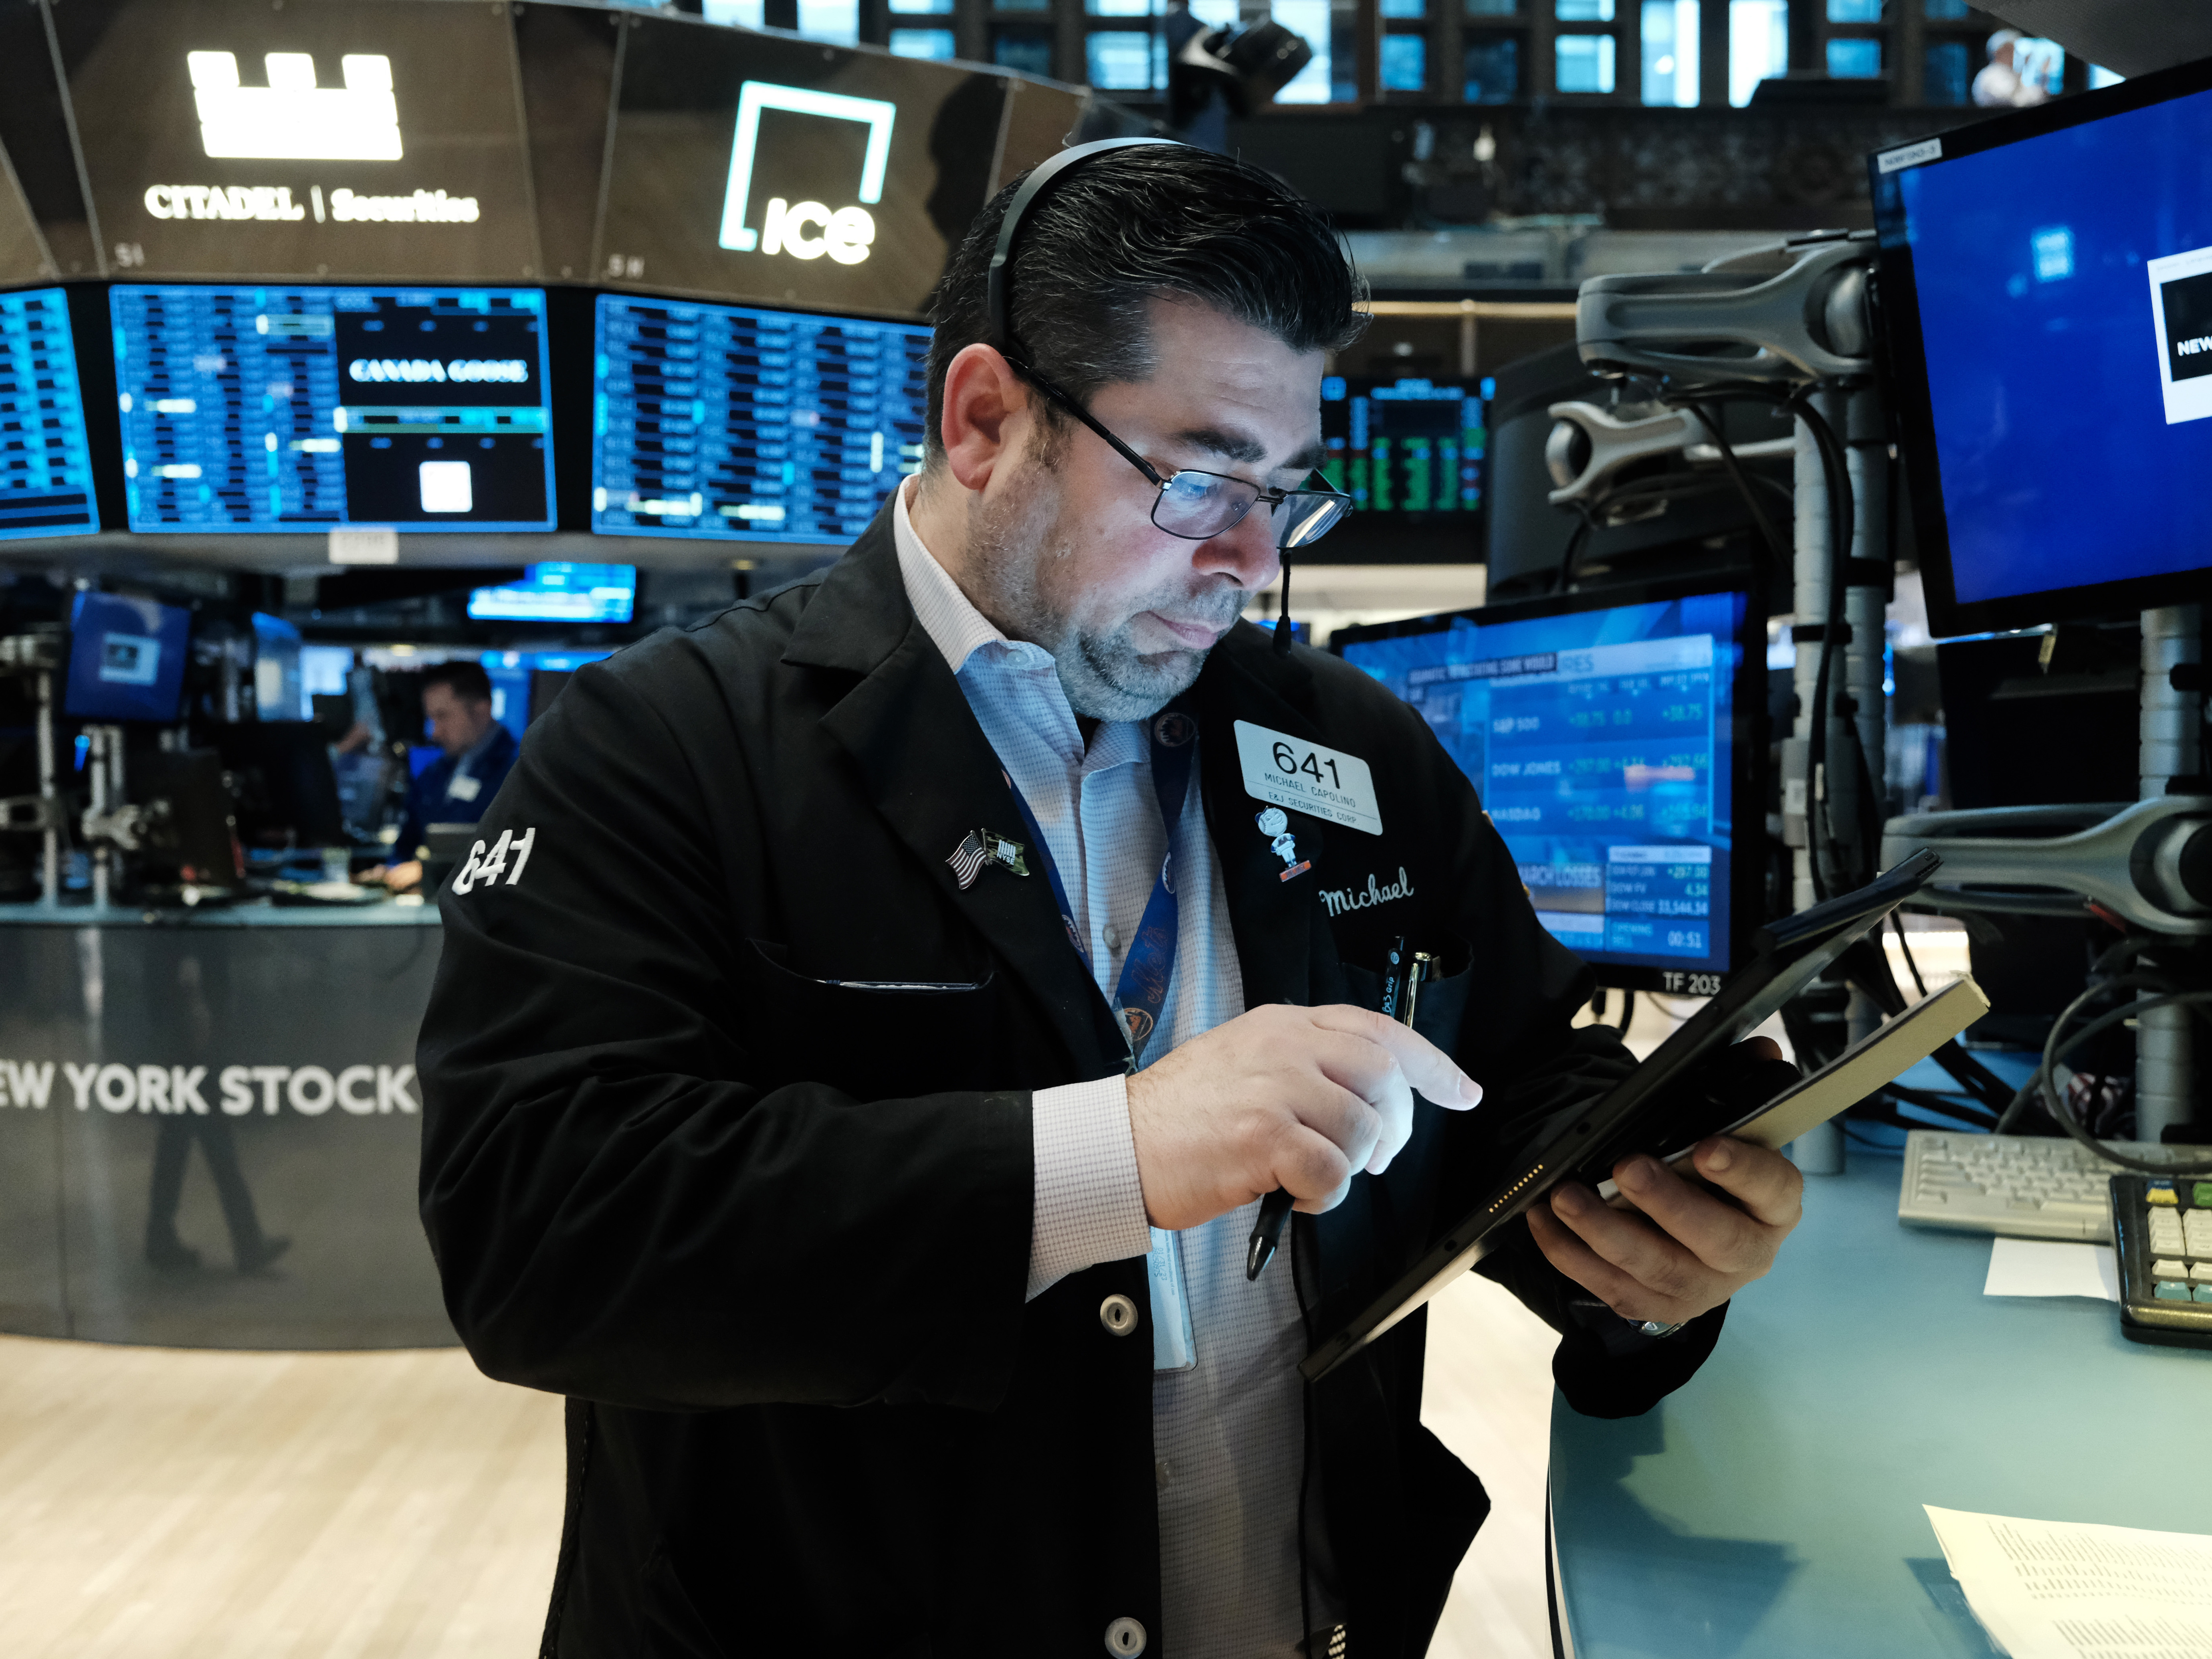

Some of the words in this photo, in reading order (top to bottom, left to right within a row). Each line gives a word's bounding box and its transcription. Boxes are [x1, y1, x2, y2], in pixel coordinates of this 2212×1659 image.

[144, 184, 305, 220] CITADEL
[331, 188, 479, 222] Securities
[1273, 742, 1341, 789] 641
[1264, 772, 1306, 792] MICHAEL
[1311, 786, 1356, 808] CAPOLINO
[1268, 791, 1284, 802] E&J
[1288, 797, 1333, 817] SECURITIES
[452, 828, 536, 895] 641
[996, 851, 1015, 865] NYSE
[1319, 866, 1414, 917] Michael
[1662, 971, 1685, 992] TF
[1688, 973, 1721, 994] 203
[0, 1059, 55, 1109] W
[63, 1062, 210, 1115] YORK
[218, 1063, 419, 1117] STOCK
